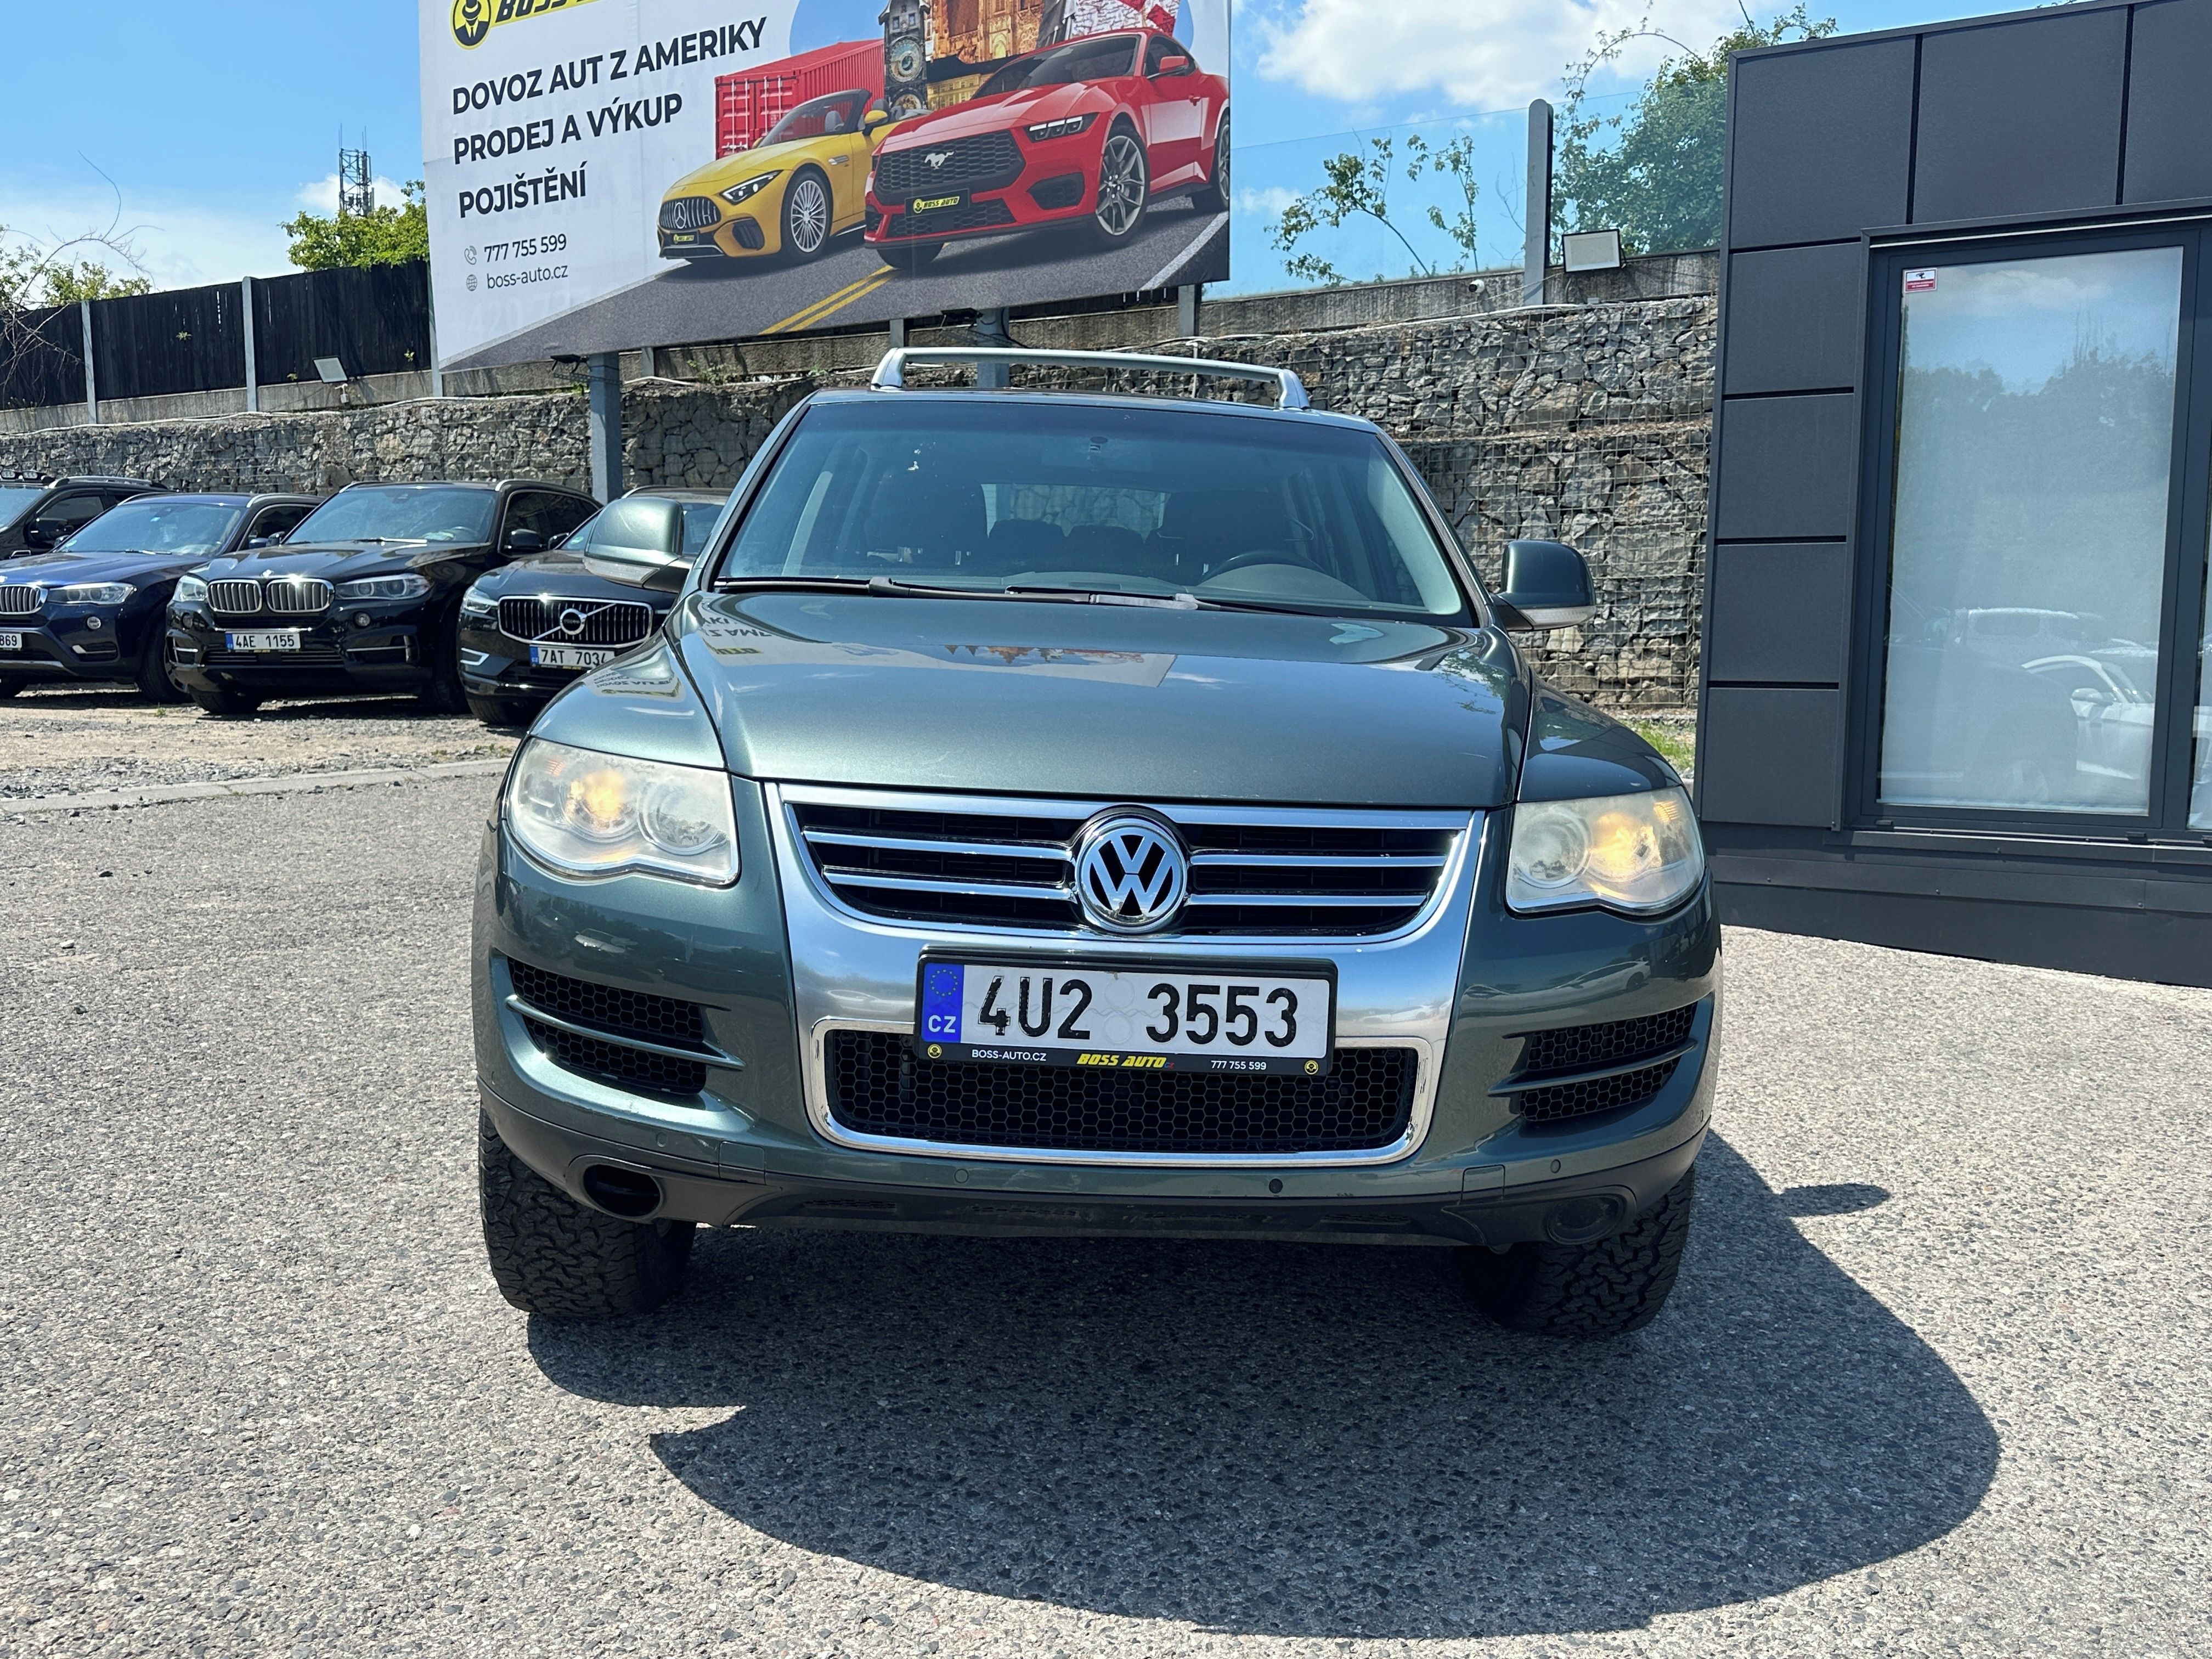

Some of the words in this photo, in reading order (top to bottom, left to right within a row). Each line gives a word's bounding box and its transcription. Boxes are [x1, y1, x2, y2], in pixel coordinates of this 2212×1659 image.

[453, 69, 543, 115] DOVOZ
[549, 55, 603, 94] AUT
[610, 49, 627, 80] Z
[634, 16, 767, 75] AMERIKY
[454, 119, 554, 165] PRODEJ
[561, 115, 582, 144] A
[586, 93, 682, 137] VÝKUP
[459, 160, 588, 218] POJIŠTĚNÍ
[484, 243, 509, 262] 777
[512, 239, 537, 258] 755
[540, 233, 567, 253] 599
[487, 266, 568, 289] boss-auto.cz
[236, 635, 256, 647] 4AE
[266, 635, 295, 647] 1155
[541, 650, 565, 663] 7AT
[978, 975, 1092, 1039] 4U2
[1146, 983, 1297, 1047] 3553
[928, 1014, 956, 1033] CZ
[972, 1049, 1047, 1062] BOSS-AUTO.CZ
[1076, 1053, 1120, 1066] BOSS
[1211, 1060, 1227, 1069] 777
[1229, 1061, 1246, 1070] 755
[1249, 1062, 1267, 1070] 599
